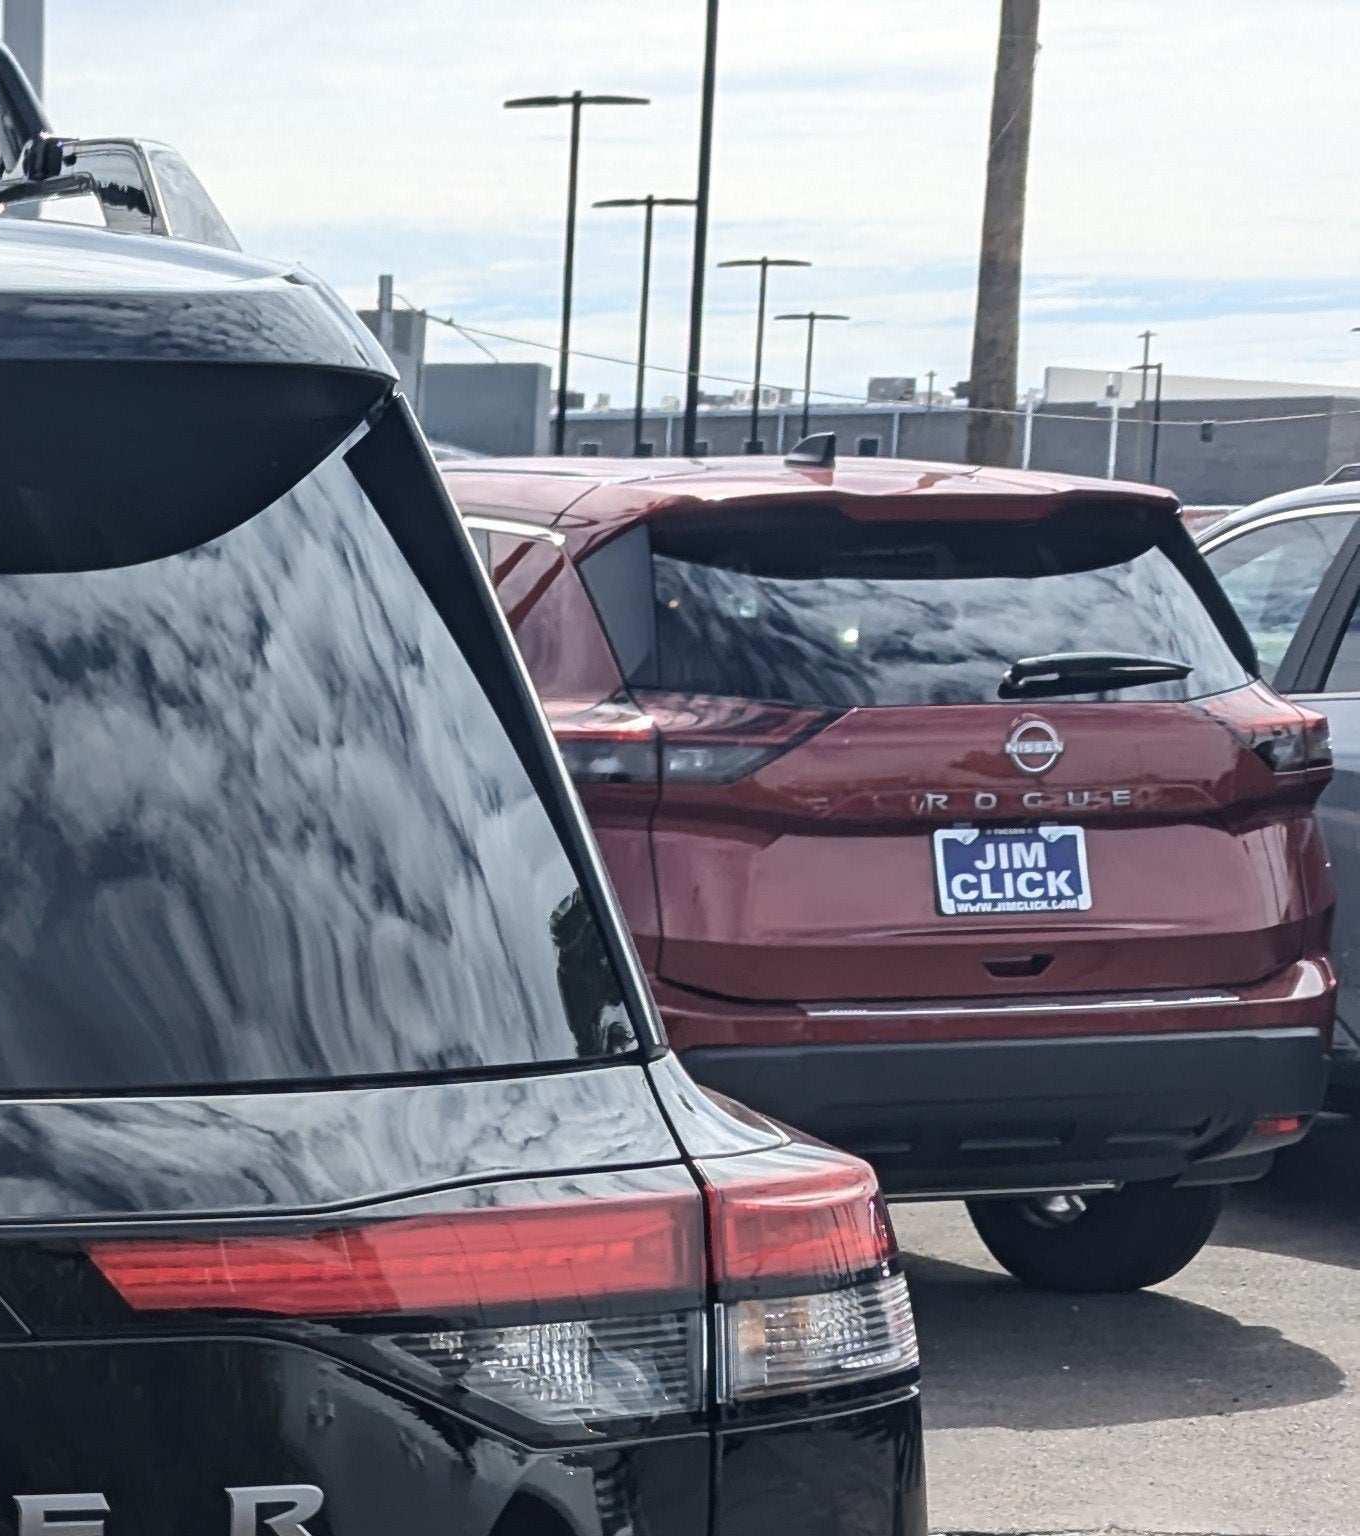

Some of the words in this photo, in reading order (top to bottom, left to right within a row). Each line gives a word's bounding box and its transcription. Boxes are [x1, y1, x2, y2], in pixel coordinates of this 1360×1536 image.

[1005, 740, 1064, 754] NISSAN
[926, 789, 1131, 811] ROGUE
[974, 841, 1047, 870] JIM
[951, 870, 1076, 900] CLICK
